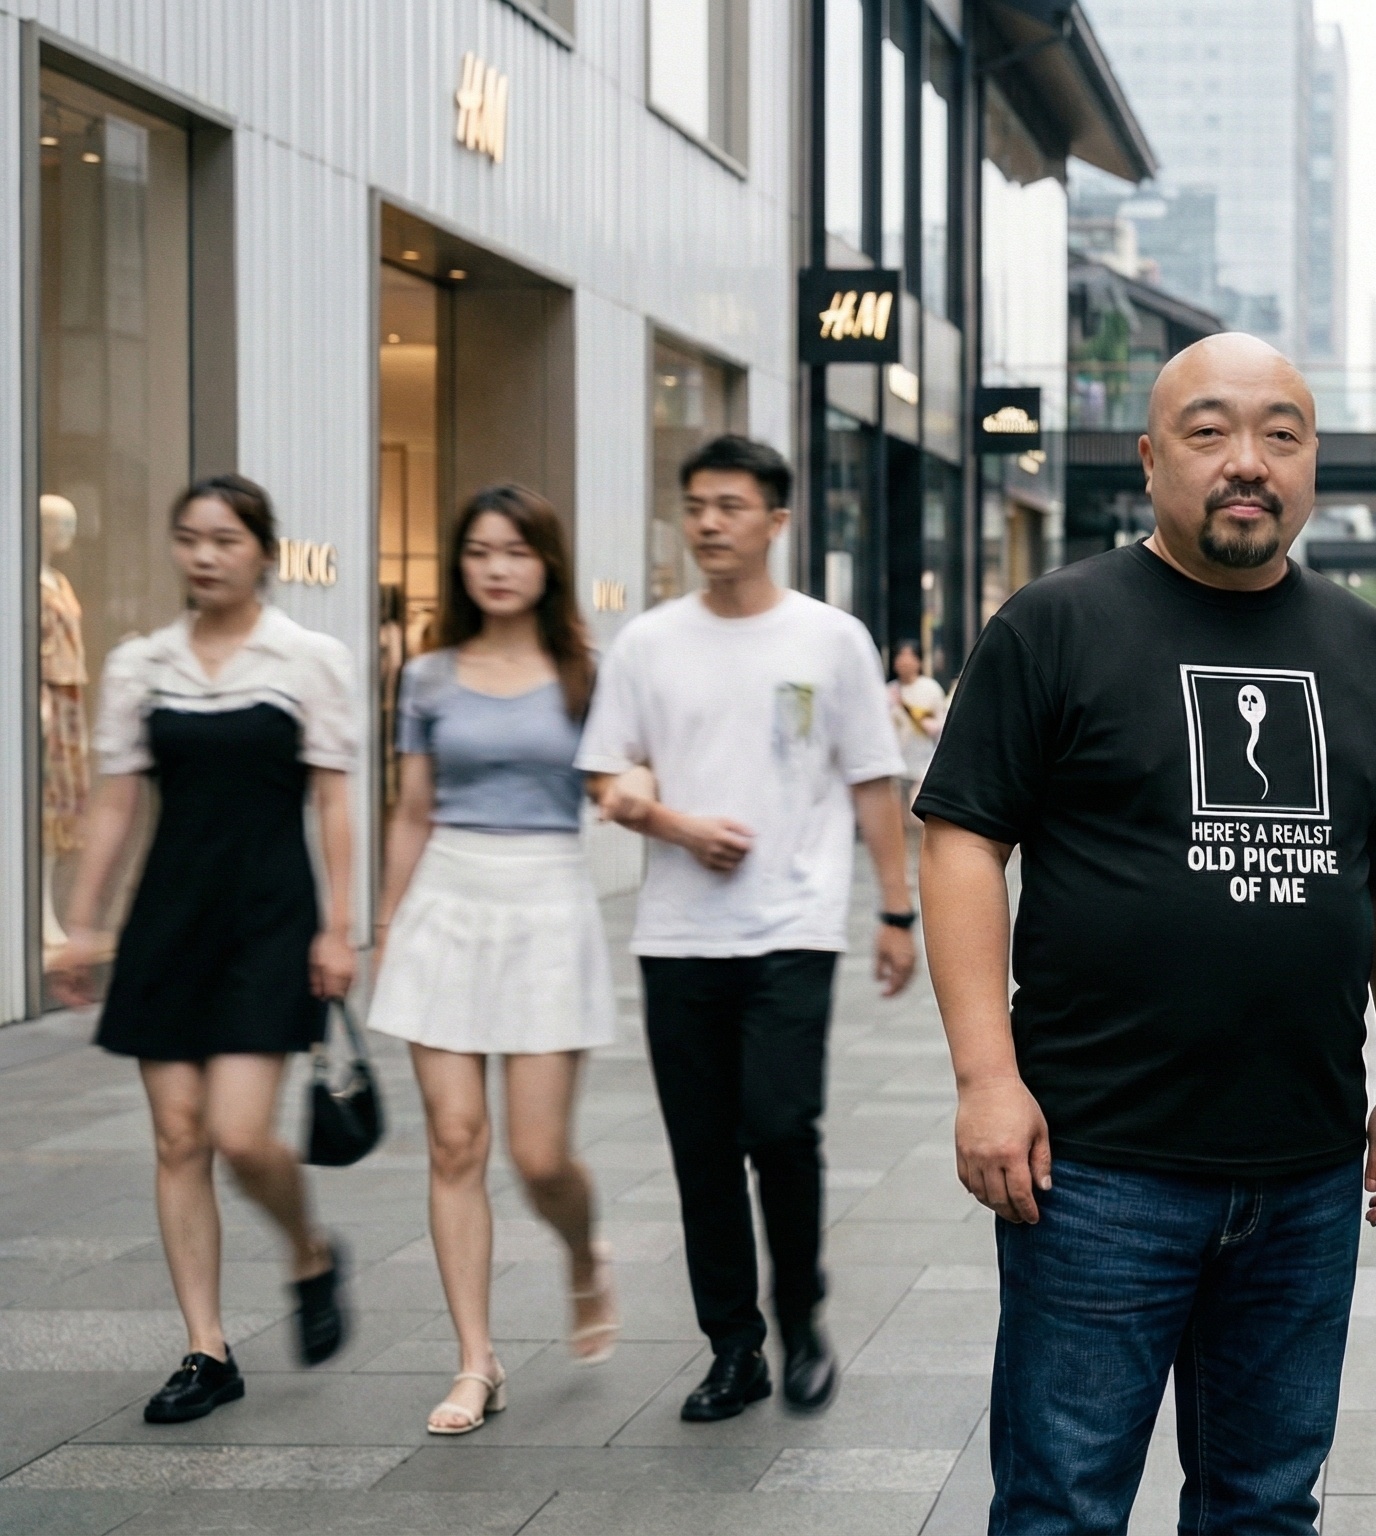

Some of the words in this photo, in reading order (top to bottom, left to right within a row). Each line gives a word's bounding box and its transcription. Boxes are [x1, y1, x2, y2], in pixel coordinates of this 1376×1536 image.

[1191, 821, 1250, 842] HERE'S
[1254, 823, 1268, 843] A
[1272, 824, 1333, 846] REALST
[1187, 845, 1236, 871] OLD
[1243, 847, 1339, 875] PICTURE
[1229, 876, 1262, 903] OF
[1269, 877, 1306, 904] ME
